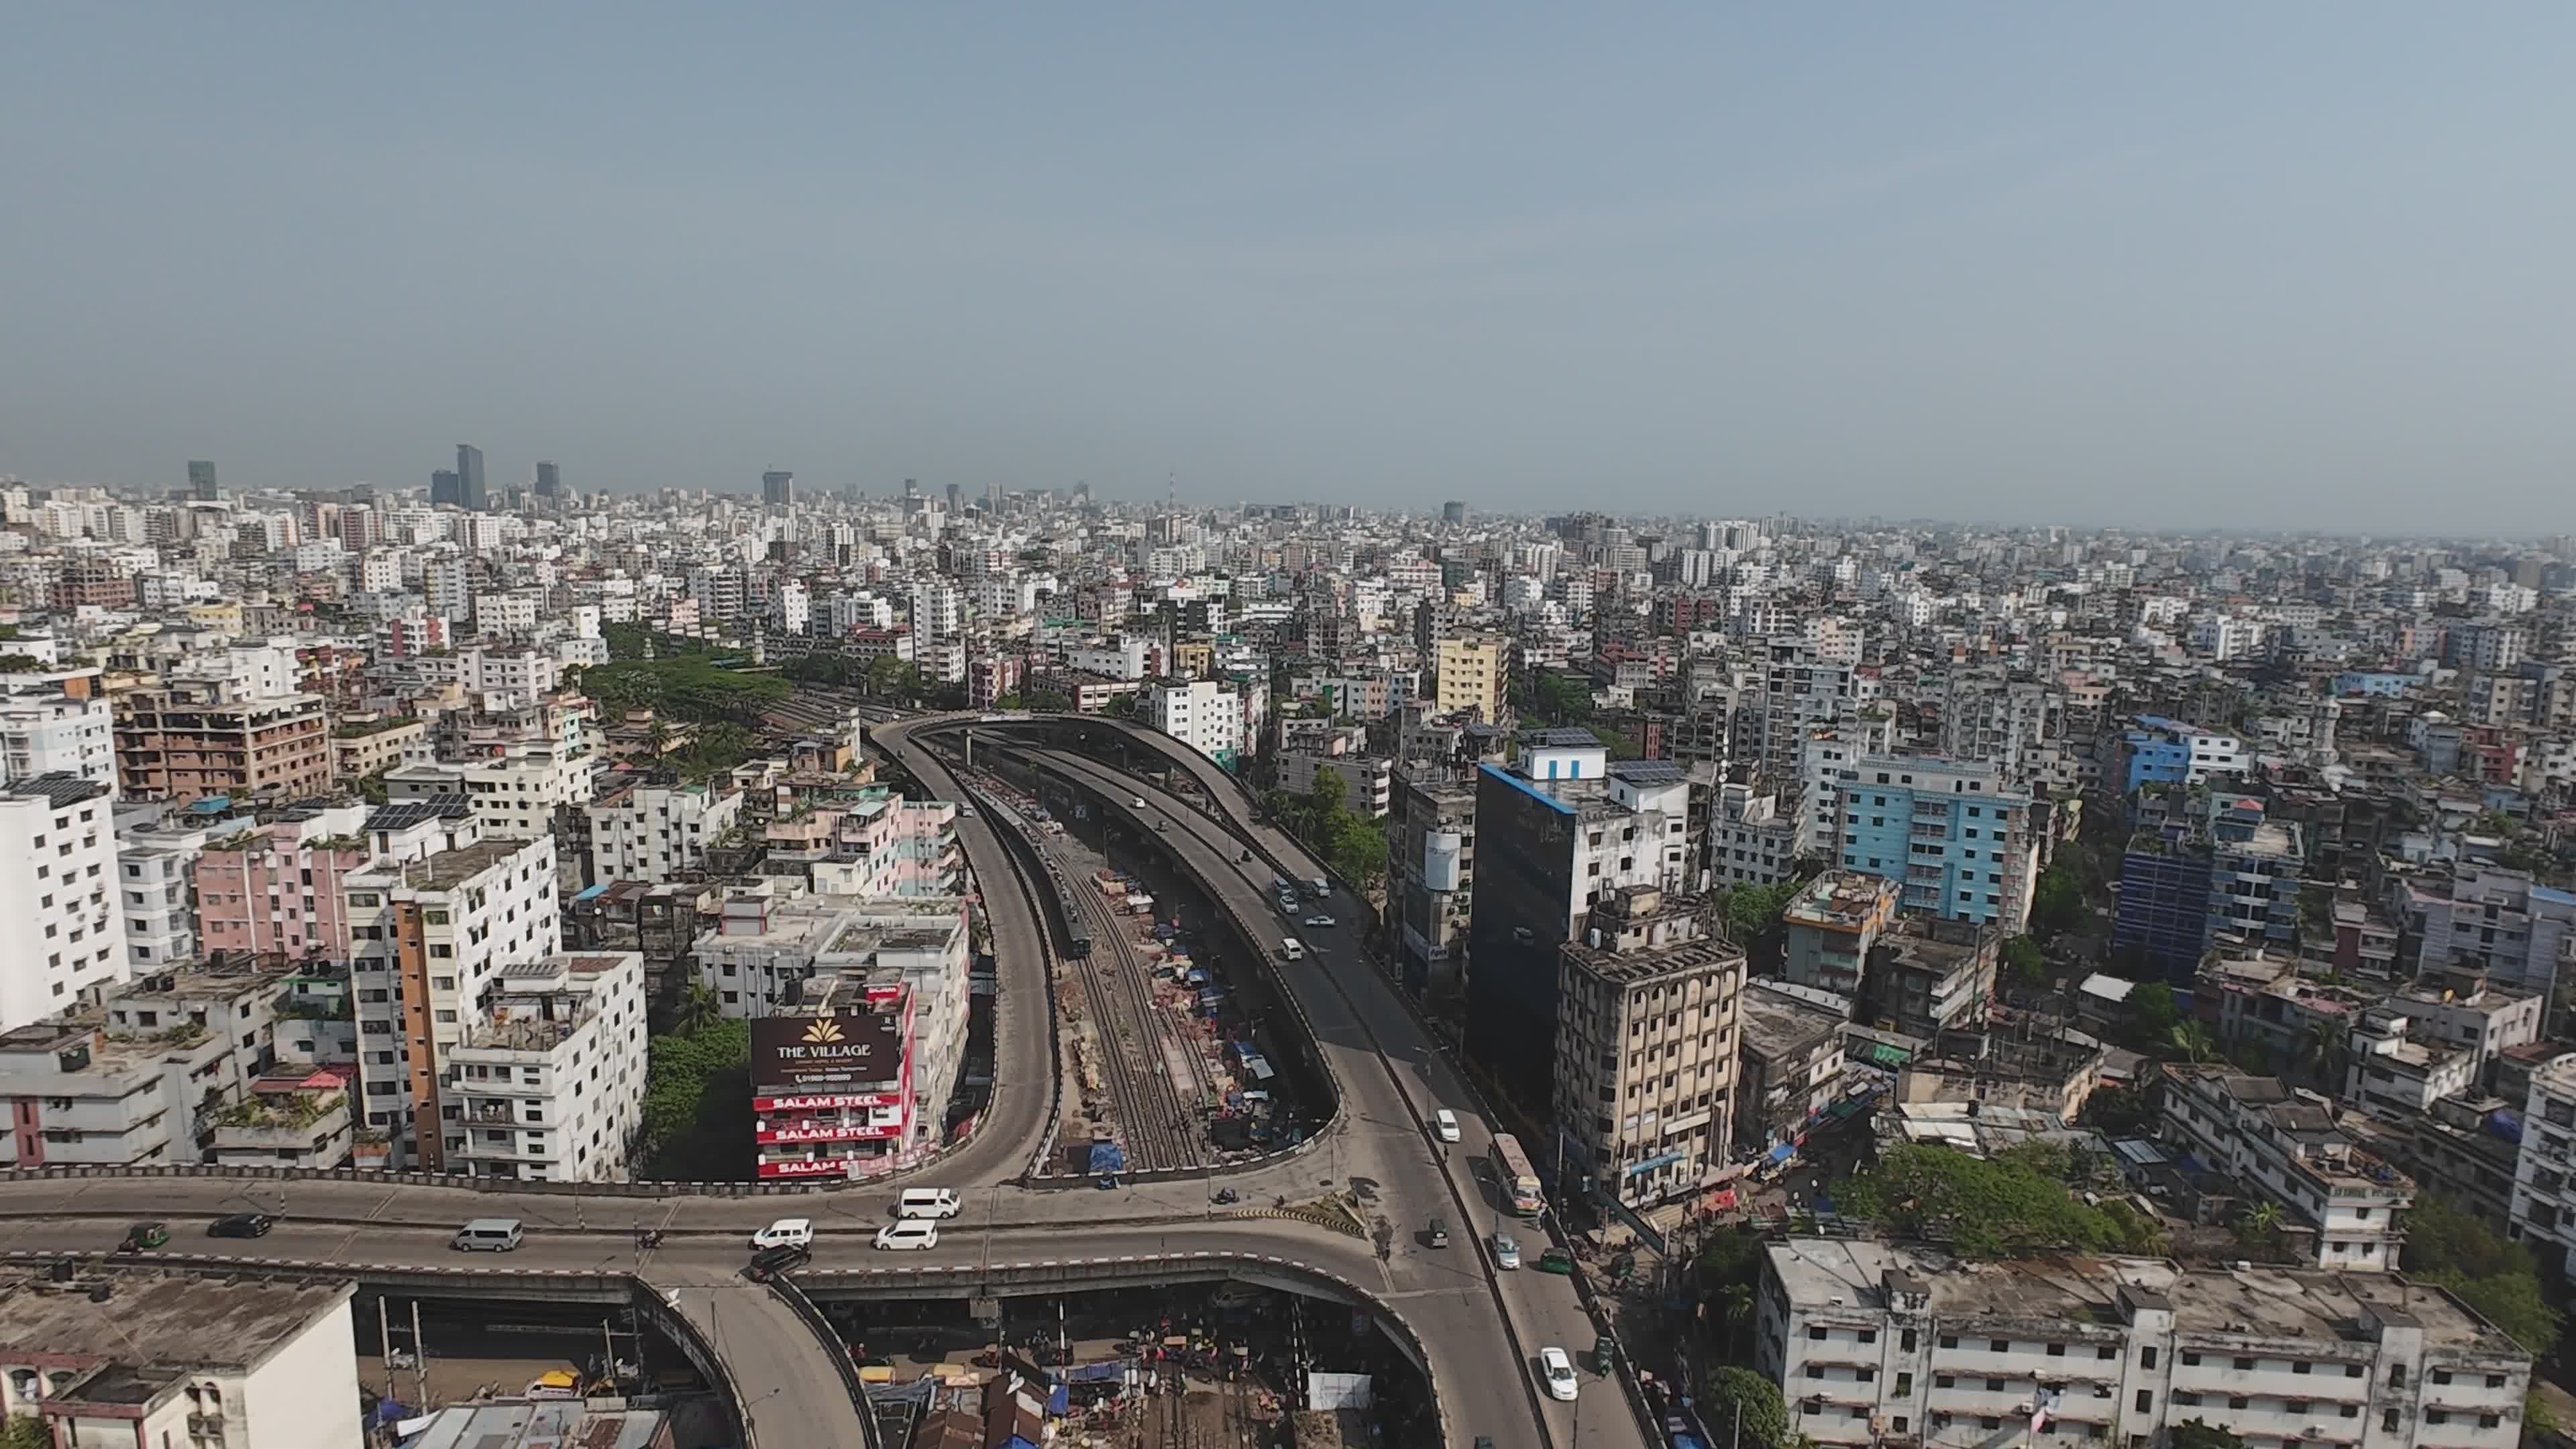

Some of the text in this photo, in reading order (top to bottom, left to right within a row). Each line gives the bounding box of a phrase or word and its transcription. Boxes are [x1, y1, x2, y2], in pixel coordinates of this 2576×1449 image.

[777, 1044, 871, 1058] THE VILLAGE
[773, 1095, 882, 1108] SALAM STEEL
[775, 1127, 885, 1140] SALAM STEEL
[778, 1161, 836, 1173] SALAM
